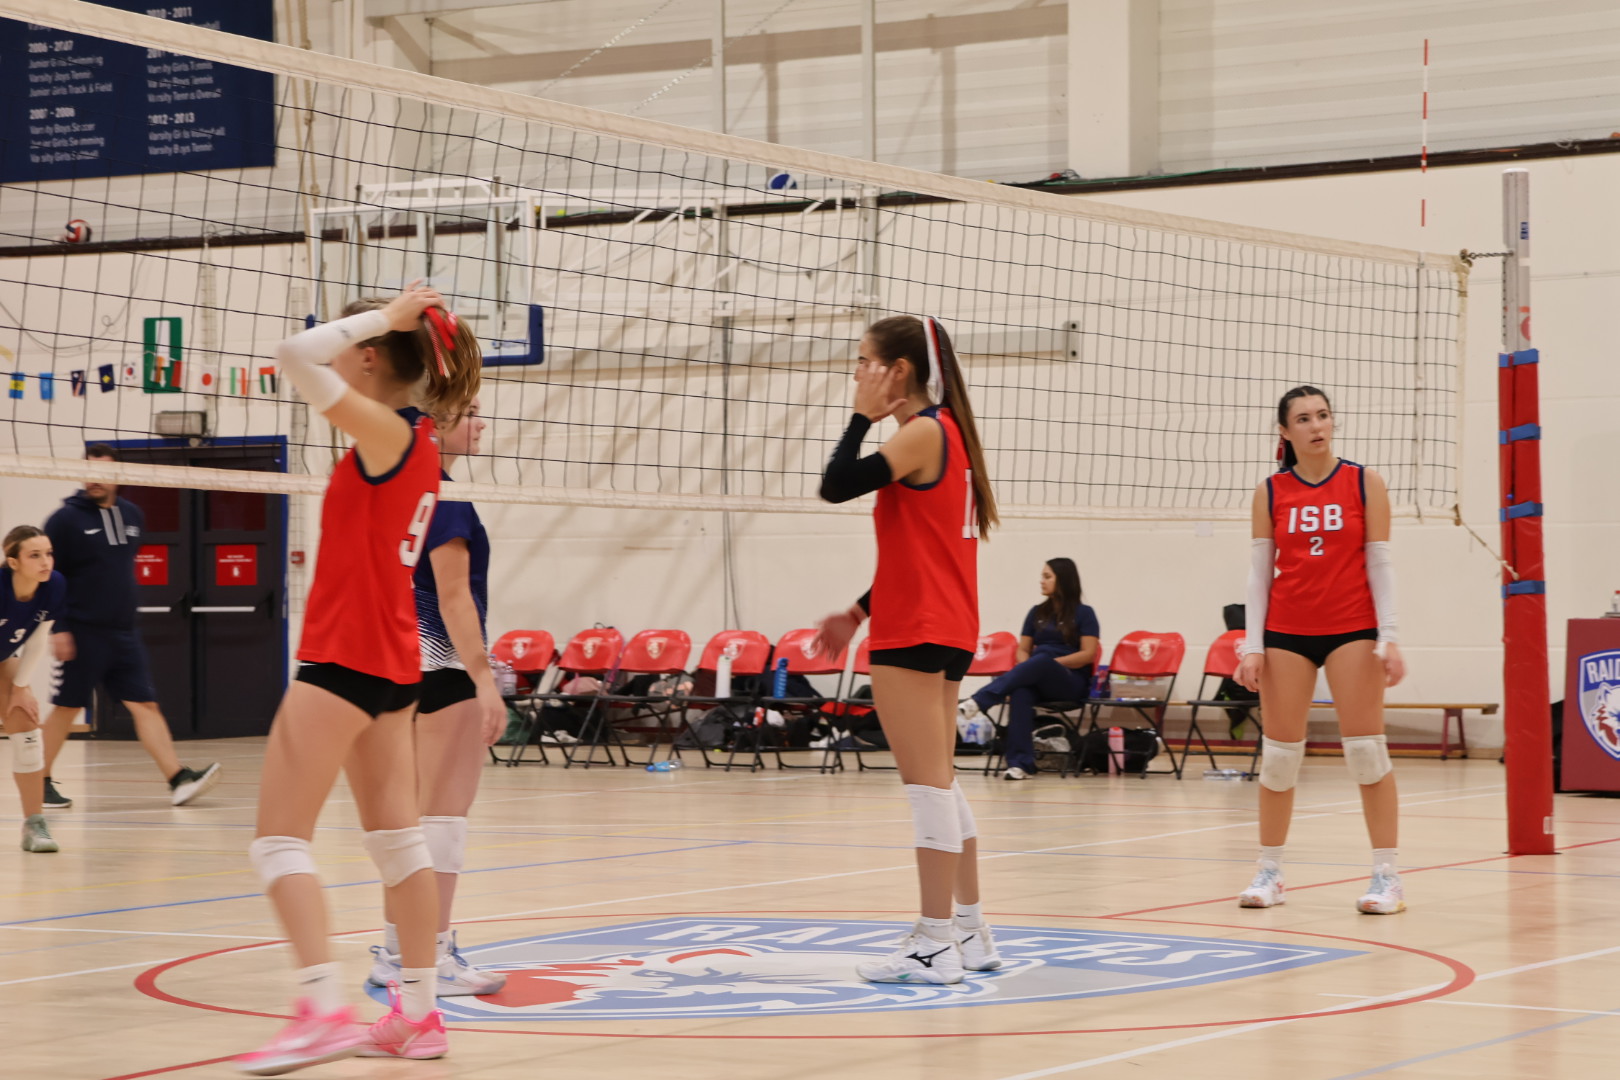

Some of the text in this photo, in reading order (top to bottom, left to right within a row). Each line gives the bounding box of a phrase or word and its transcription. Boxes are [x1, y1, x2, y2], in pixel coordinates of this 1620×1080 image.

[398, 491, 436, 568] 9
[1288, 503, 1344, 534] ISB
[1309, 536, 1324, 556] 2
